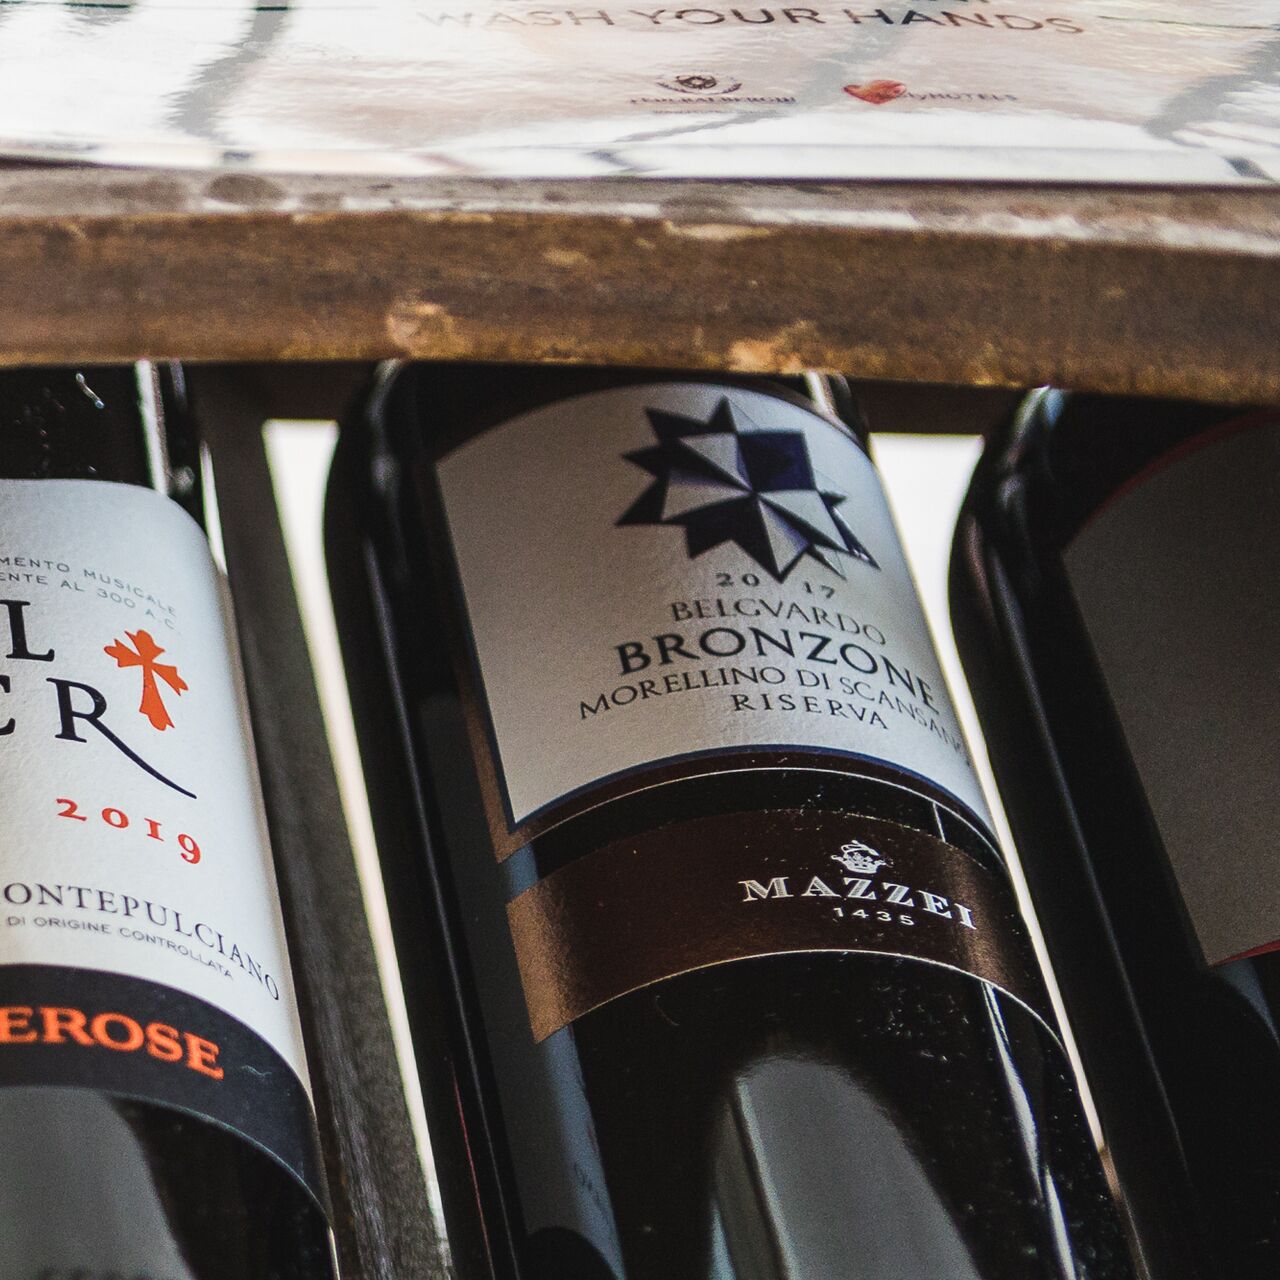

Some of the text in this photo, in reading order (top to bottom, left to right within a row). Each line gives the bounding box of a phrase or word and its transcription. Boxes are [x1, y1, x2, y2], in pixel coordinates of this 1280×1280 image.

[416, 7, 1086, 34] WASH YOUR HANDS
[60, 579, 85, 593] AL
[96, 588, 137, 610] 300
[83, 568, 177, 617] MUSICALE
[670, 598, 887, 647] BELGVARDO
[615, 626, 940, 715] BRONZONE
[580, 666, 970, 767] MORELLINO DI SCANSAN
[731, 693, 889, 730] RISERVA
[55, 798, 202, 865] 2019
[738, 876, 979, 930] MAZZEI
[832, 905, 916, 927] 1435
[7, 915, 27, 927] DI
[33, 916, 113, 935] ORIGINE
[118, 927, 234, 979] CONTROLLATA
